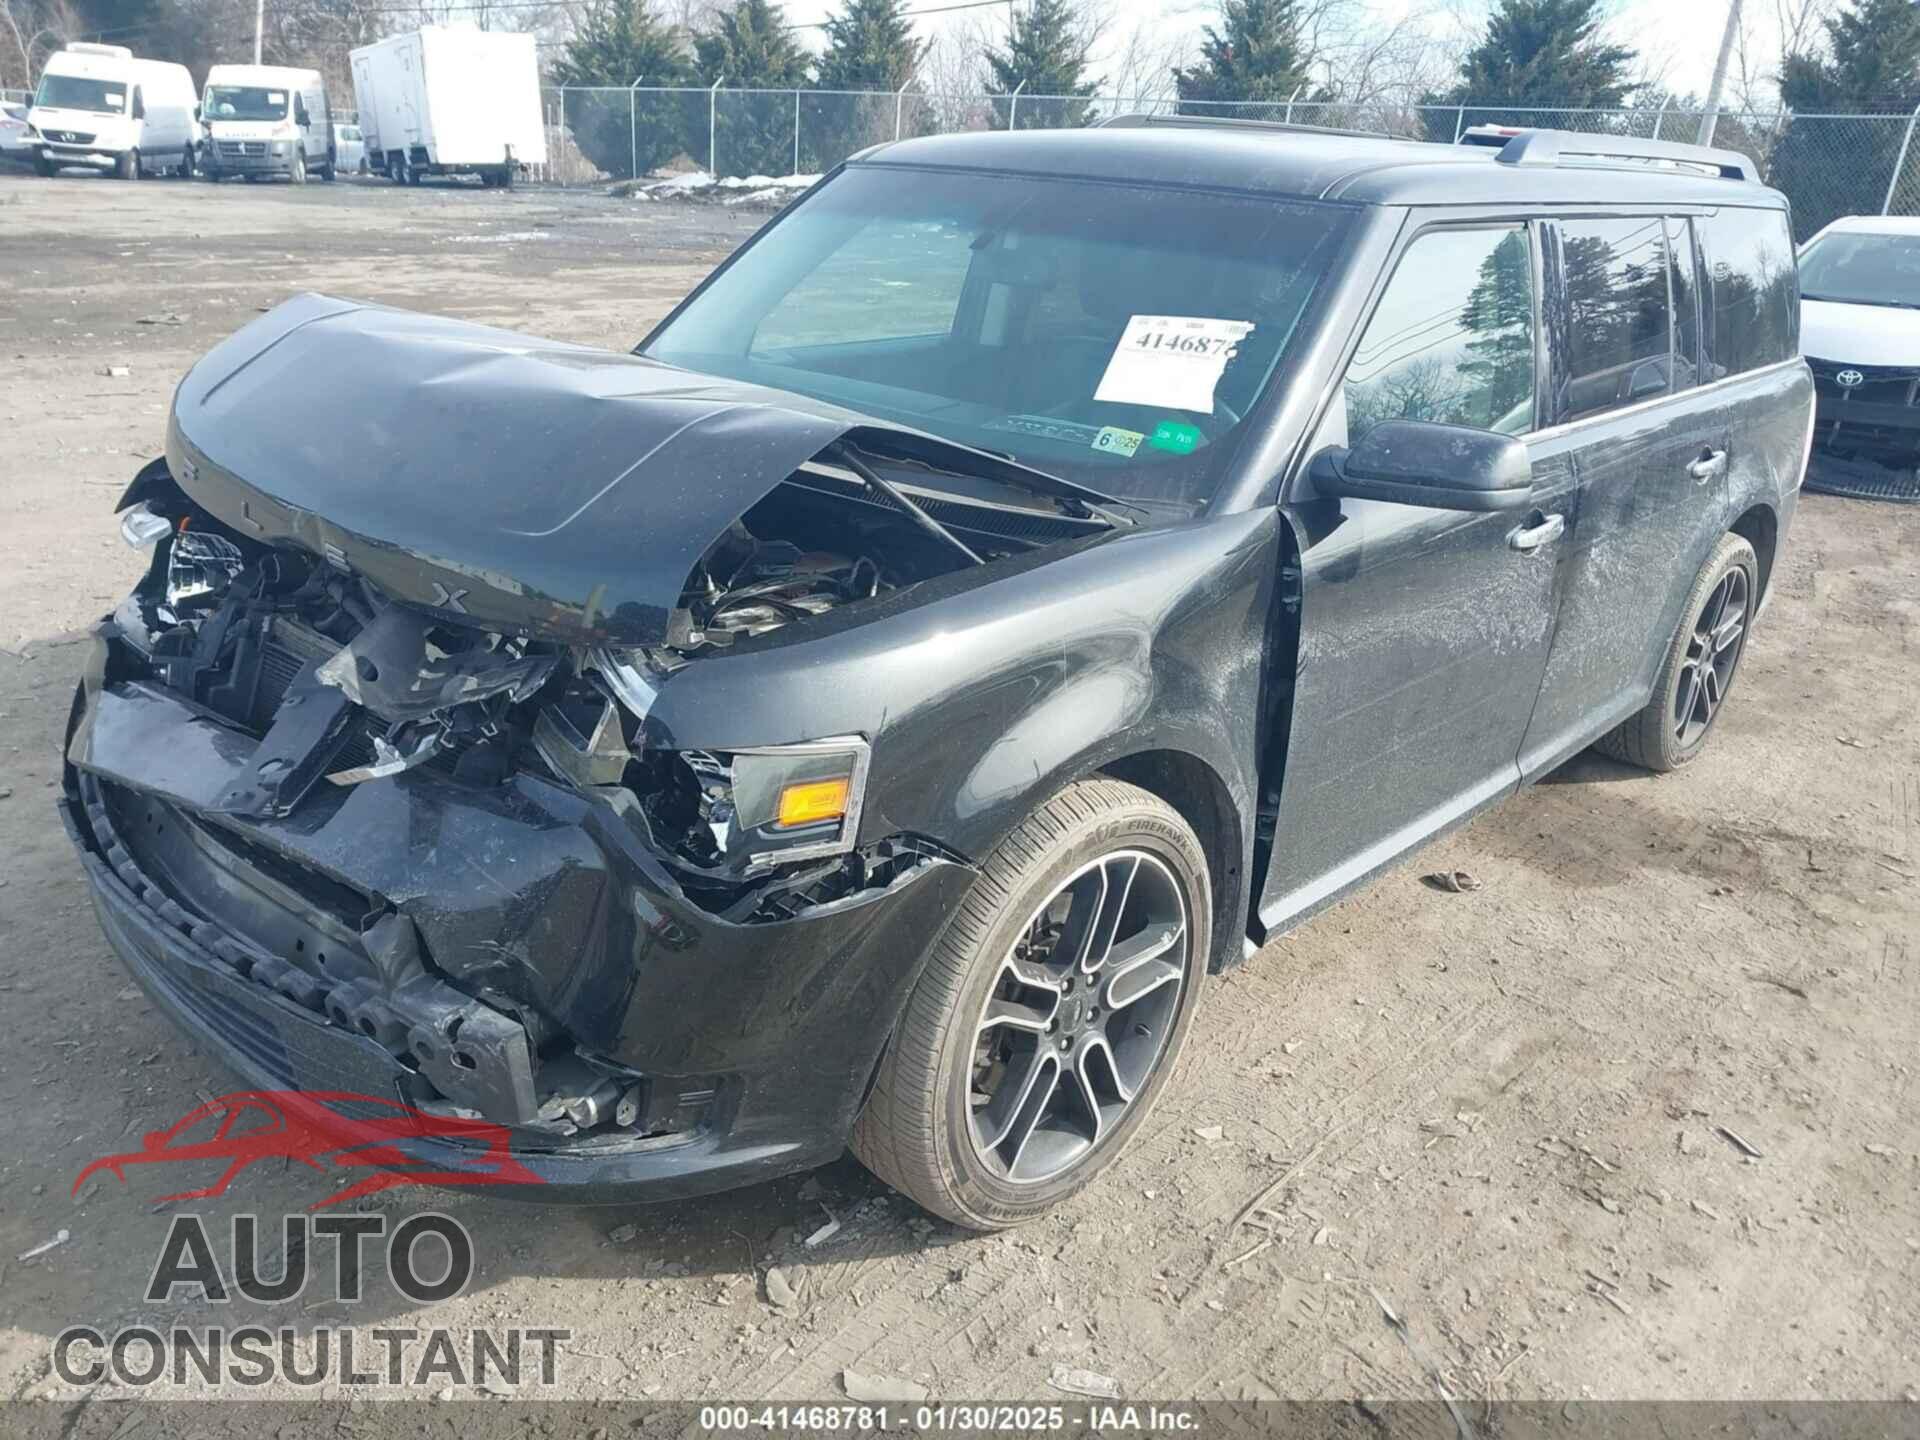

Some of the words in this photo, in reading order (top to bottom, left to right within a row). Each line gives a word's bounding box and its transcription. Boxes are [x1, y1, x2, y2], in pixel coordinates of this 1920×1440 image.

[1100, 433, 1113, 446] 6
[1124, 437, 1140, 449] 25
[1127, 819, 1190, 852] FIREHAWK
